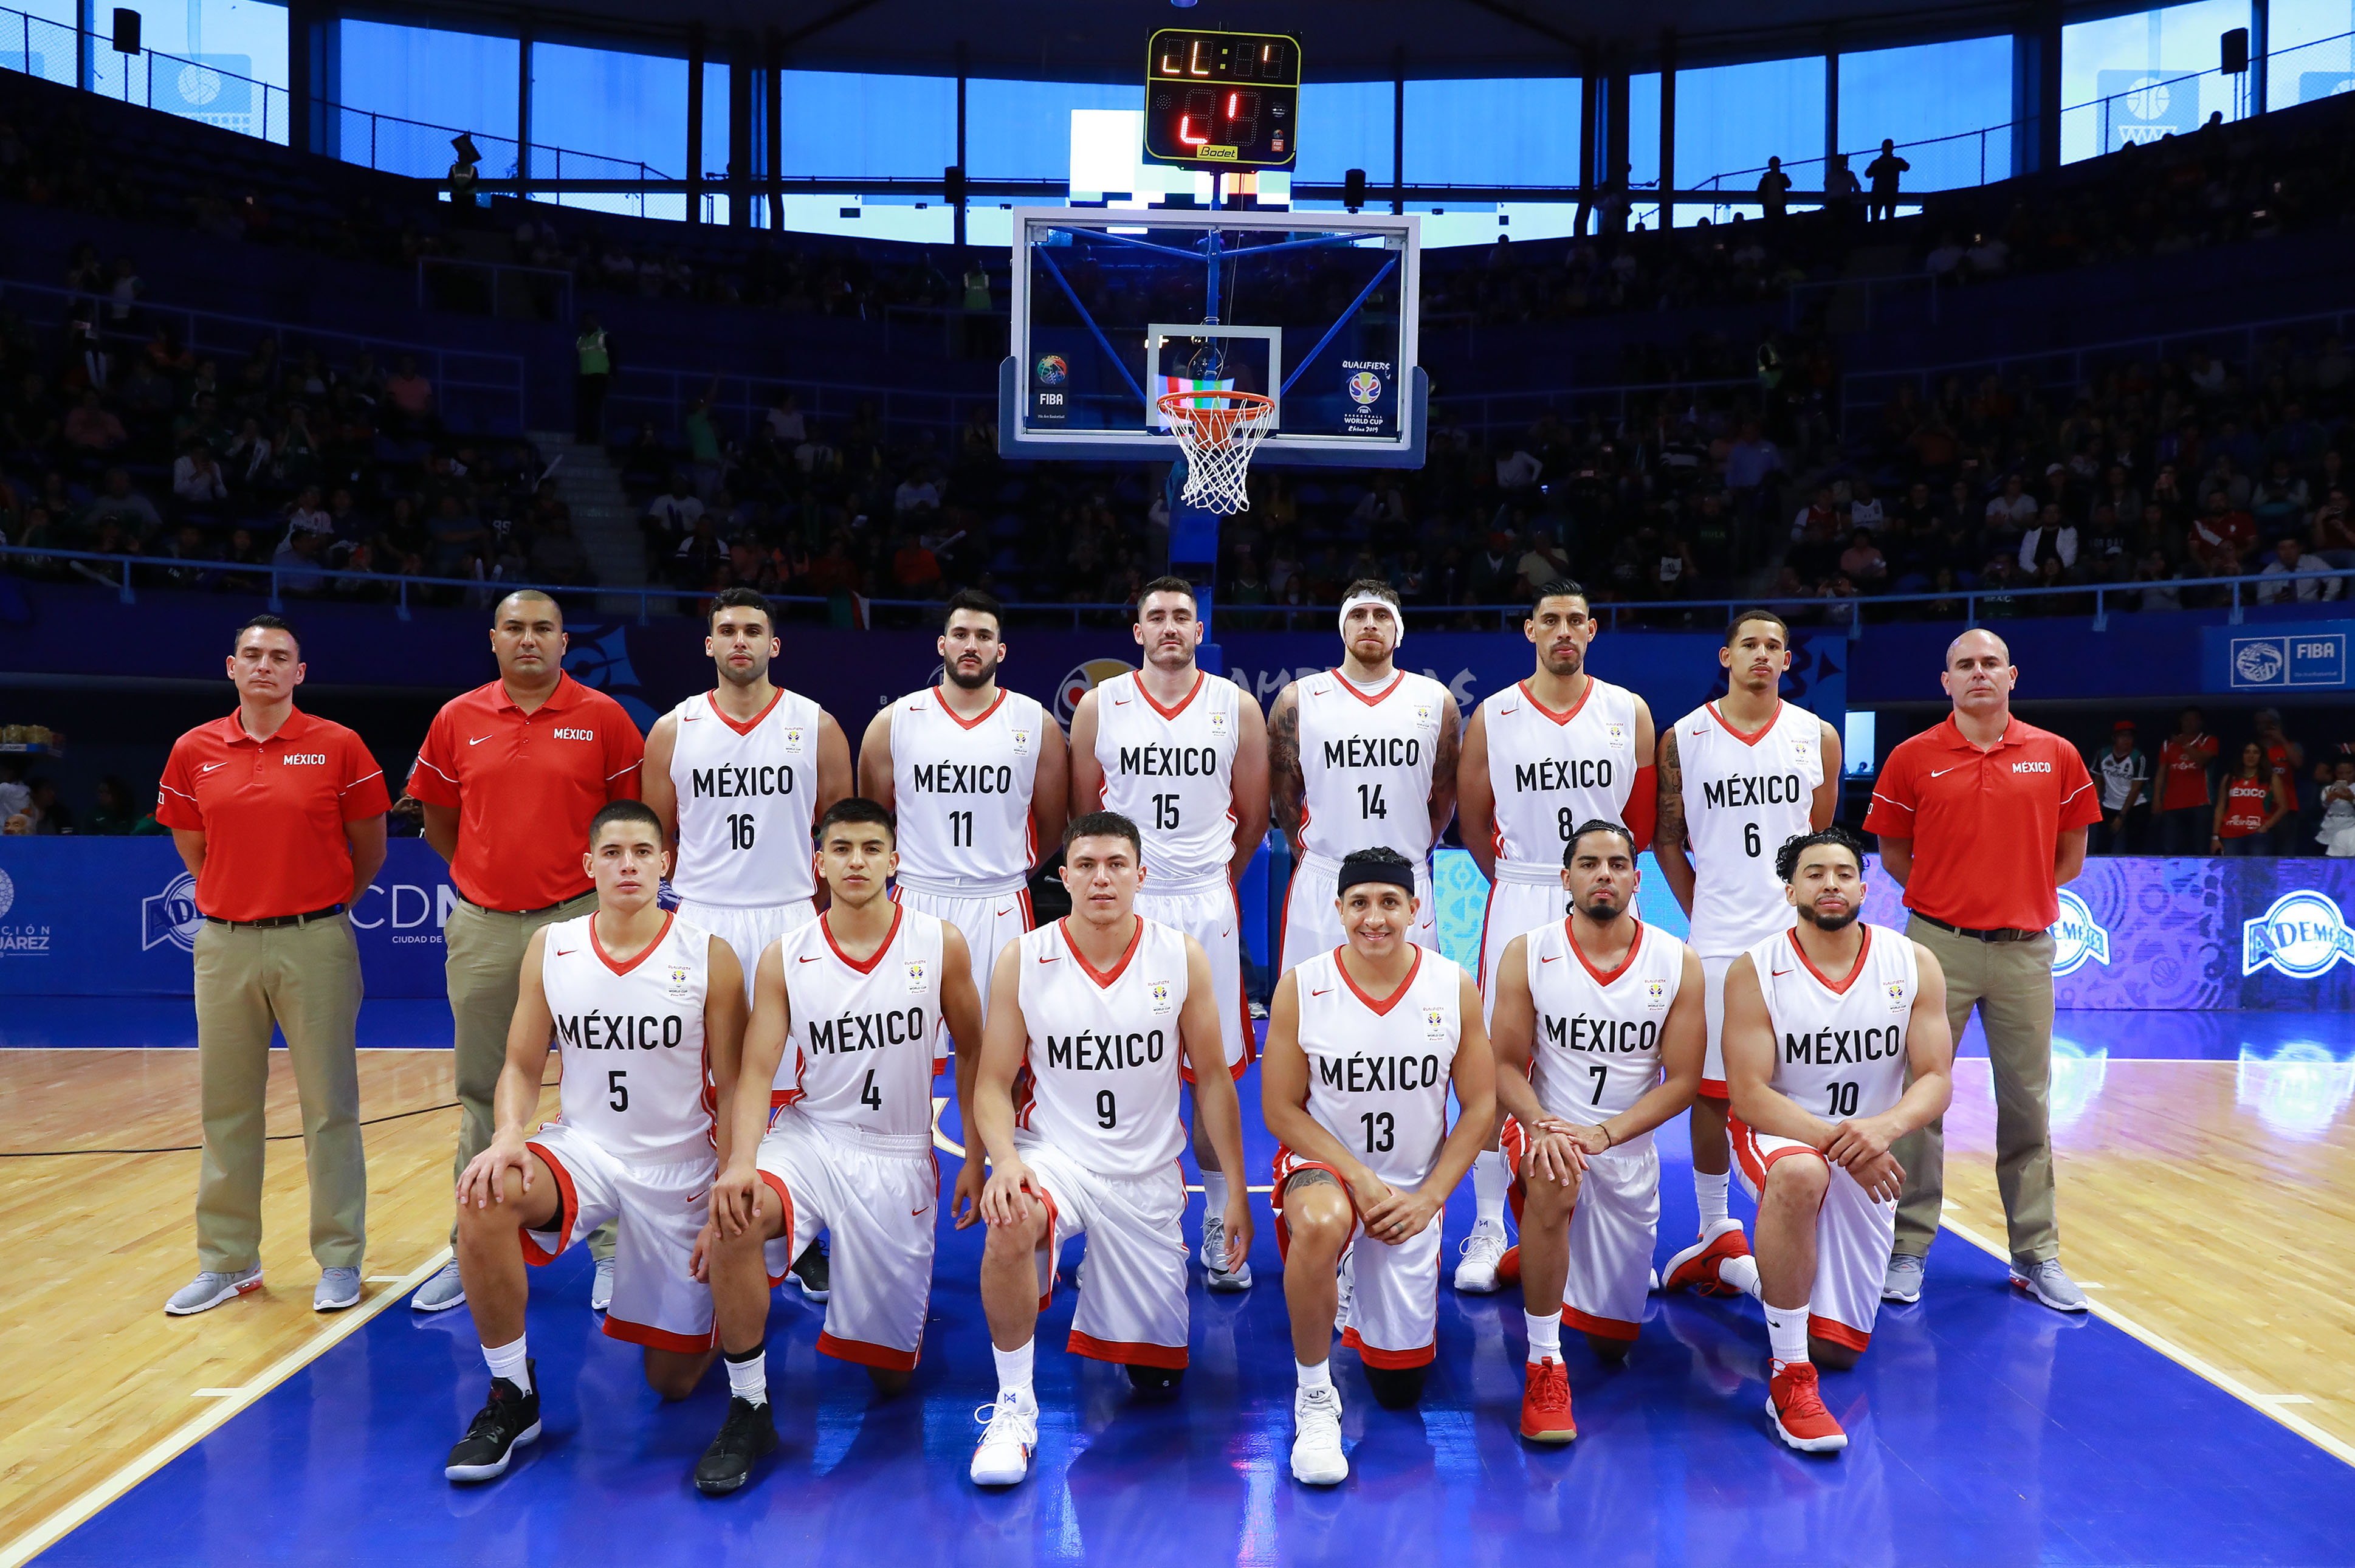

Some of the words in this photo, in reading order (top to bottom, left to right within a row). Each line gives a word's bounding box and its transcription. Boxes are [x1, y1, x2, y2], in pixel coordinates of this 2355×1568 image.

[1200, 146, 1236, 158] Bodet
[1342, 360, 1391, 370] QUALIFIERS
[1040, 393, 1064, 405] FIBA
[2297, 642, 2334, 659] FIBA
[554, 727, 593, 741] MÉXICO
[1324, 734, 1418, 768] MÉXICO
[283, 754, 326, 766] MÉXICO
[1121, 742, 1216, 776] MÉXICO
[1516, 758, 1612, 792] MÉXICO
[2012, 760, 2051, 774] MÉXICO
[693, 763, 793, 797] MÉXICO
[914, 760, 1011, 794] MÉXICO
[1704, 774, 1800, 809] MÉXICO
[1152, 794, 1180, 830] 15
[1358, 785, 1386, 819] 14
[727, 814, 755, 850] 16
[949, 811, 972, 847] 11
[1558, 808, 1573, 842] 8
[1745, 823, 1761, 858] 6
[559, 1009, 682, 1050] MÉXICO
[810, 1008, 923, 1054] MÉXICO
[1545, 1013, 1657, 1053] MÉXICO
[1786, 1025, 1899, 1065] MÉXICO
[1047, 1030, 1163, 1071] MÉXICO
[1319, 1051, 1439, 1092] MÉXICO
[1589, 1066, 1607, 1105] 7
[609, 1071, 628, 1112] 5
[861, 1069, 882, 1111] 4
[1826, 1082, 1859, 1116] 10
[1096, 1090, 1116, 1129] 9
[1361, 1112, 1394, 1154] 13
